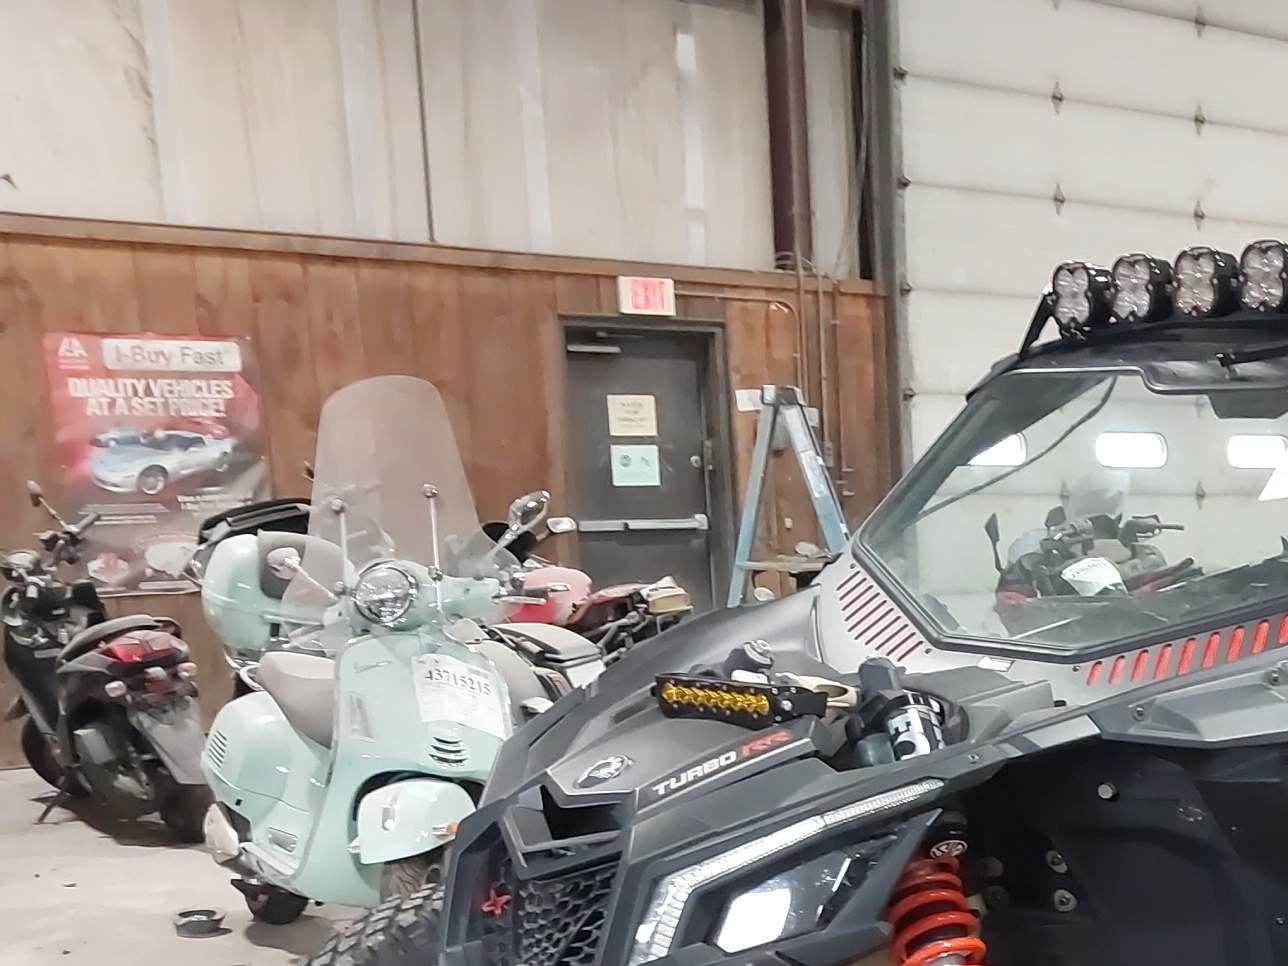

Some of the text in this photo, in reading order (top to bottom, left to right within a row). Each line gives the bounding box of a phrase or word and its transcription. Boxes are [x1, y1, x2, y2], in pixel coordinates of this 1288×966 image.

[115, 344, 171, 367] I-Buy
[179, 346, 224, 366] Fast
[67, 377, 235, 399] QUALITY VEHICLES
[85, 399, 227, 417] AT A SET PRICE!
[424, 668, 492, 695] 43715215
[652, 750, 738, 796] TURBO
